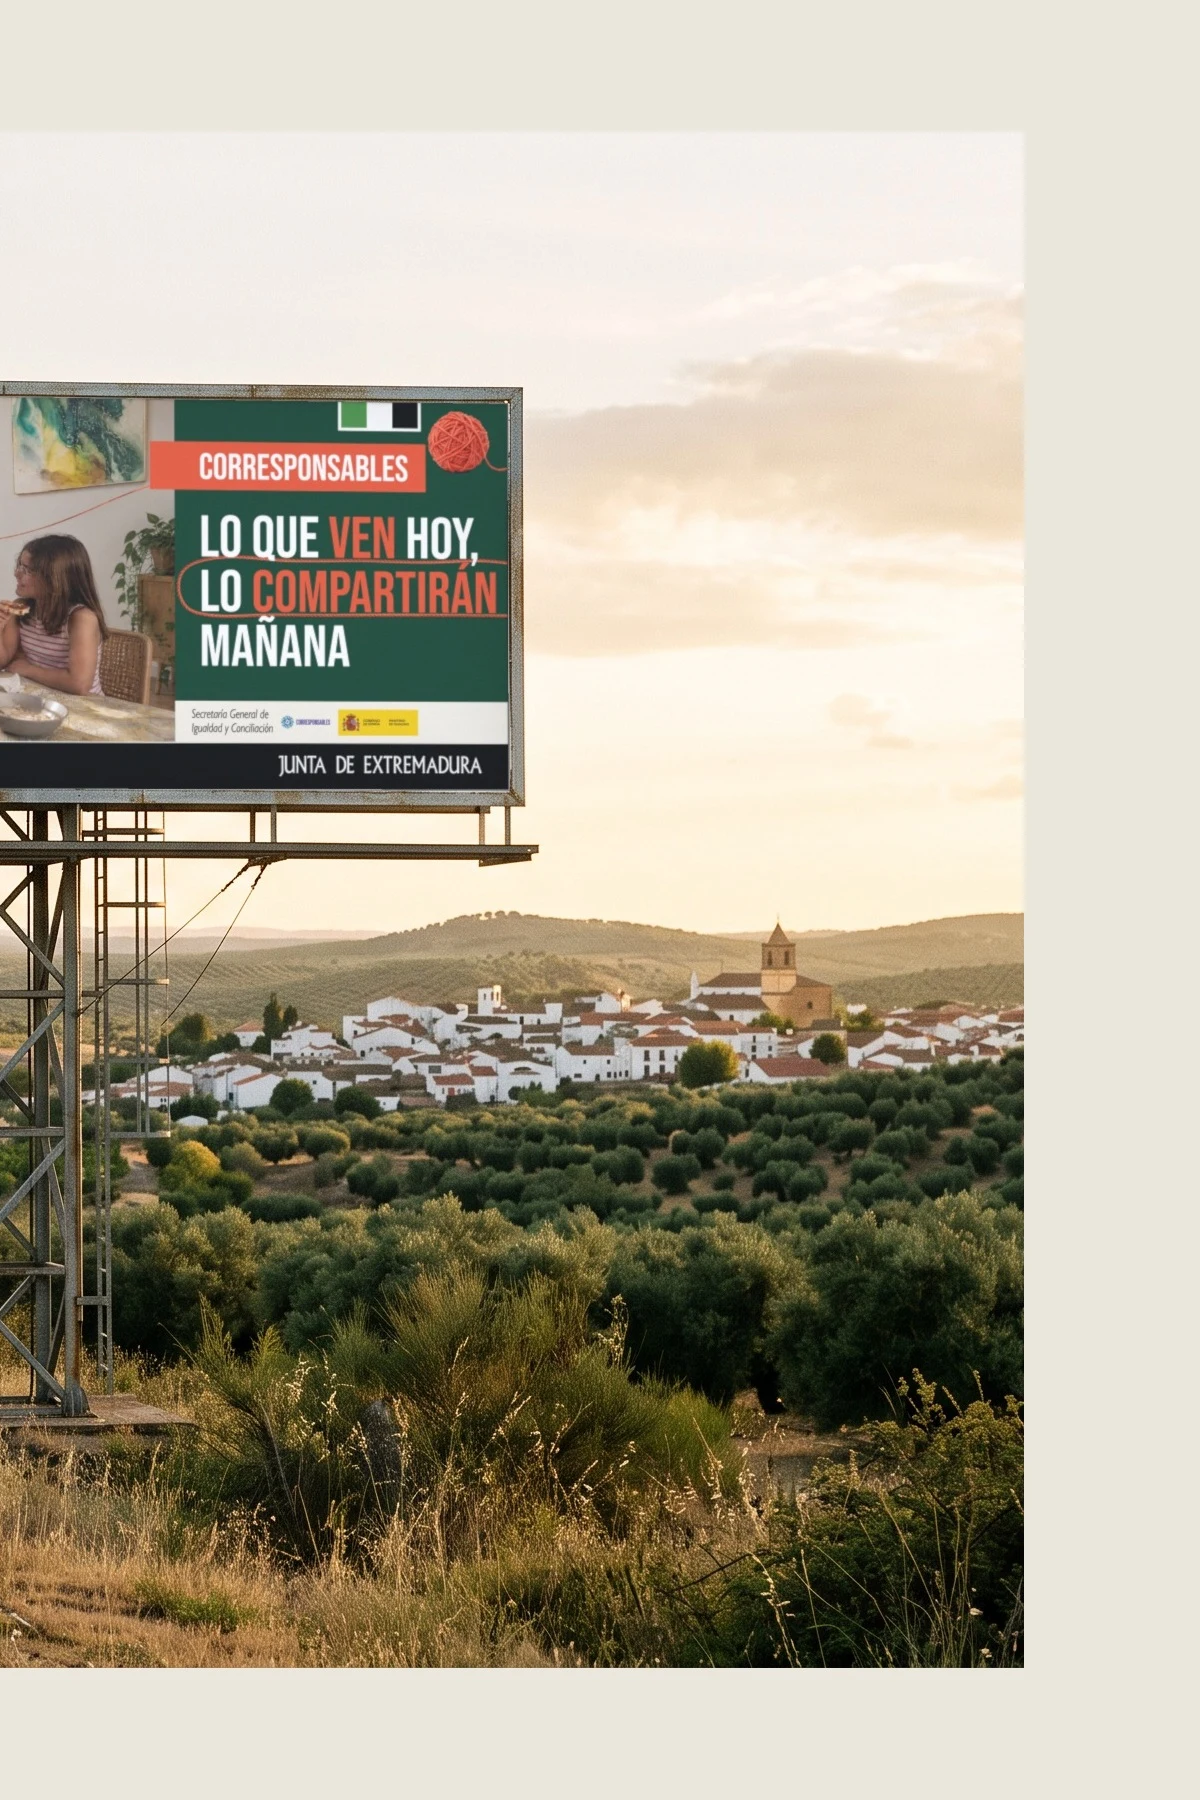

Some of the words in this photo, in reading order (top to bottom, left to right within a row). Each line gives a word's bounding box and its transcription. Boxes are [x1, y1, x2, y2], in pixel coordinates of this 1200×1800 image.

[199, 452, 408, 482] CORRESPONSABLES
[201, 514, 241, 558] LO
[253, 514, 319, 561] QUE
[329, 516, 395, 559] VEN
[407, 516, 479, 566] HOY,
[201, 569, 242, 613] LO
[253, 561, 497, 614] COMPARTIRÁN
[201, 615, 350, 667] MAÑANA
[191, 708, 228, 719] Secretaría
[229, 708, 258, 719] General
[259, 708, 270, 719] de
[191, 722, 223, 736] Igualdad
[224, 724, 230, 736] y
[230, 722, 274, 734] Conciliación
[278, 754, 327, 777] JUNTA
[335, 755, 355, 775] DE
[363, 755, 483, 775] EXTREMADURA
